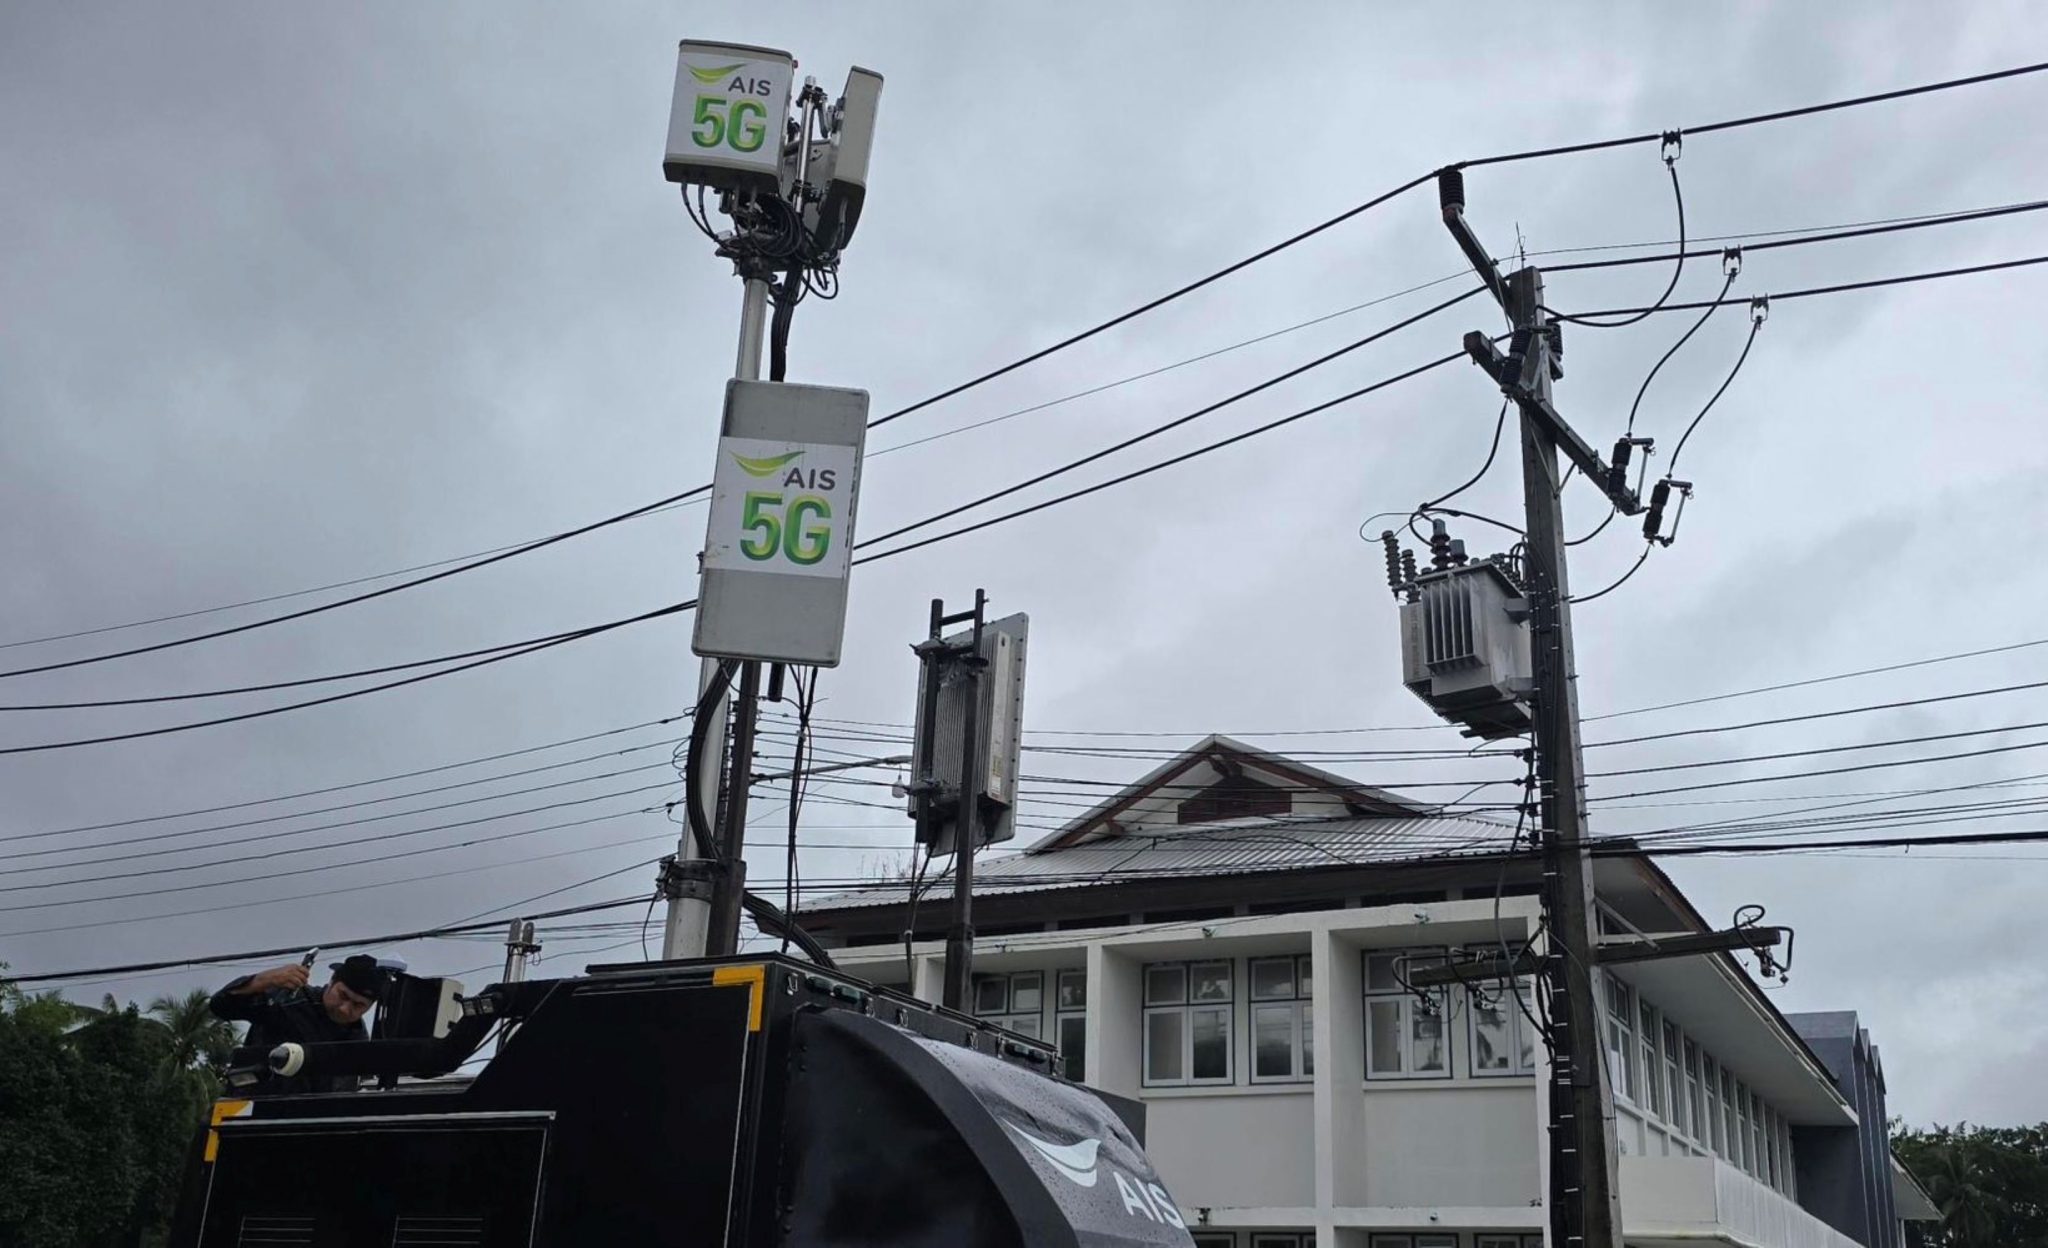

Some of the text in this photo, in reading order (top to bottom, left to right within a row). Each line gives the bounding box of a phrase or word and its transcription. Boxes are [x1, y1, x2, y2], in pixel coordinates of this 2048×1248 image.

[727, 76, 771, 97] AIS
[691, 94, 768, 153] 5G
[783, 467, 836, 491] AIS
[739, 490, 833, 565] 5G
[1113, 1171, 1185, 1229] AIS
